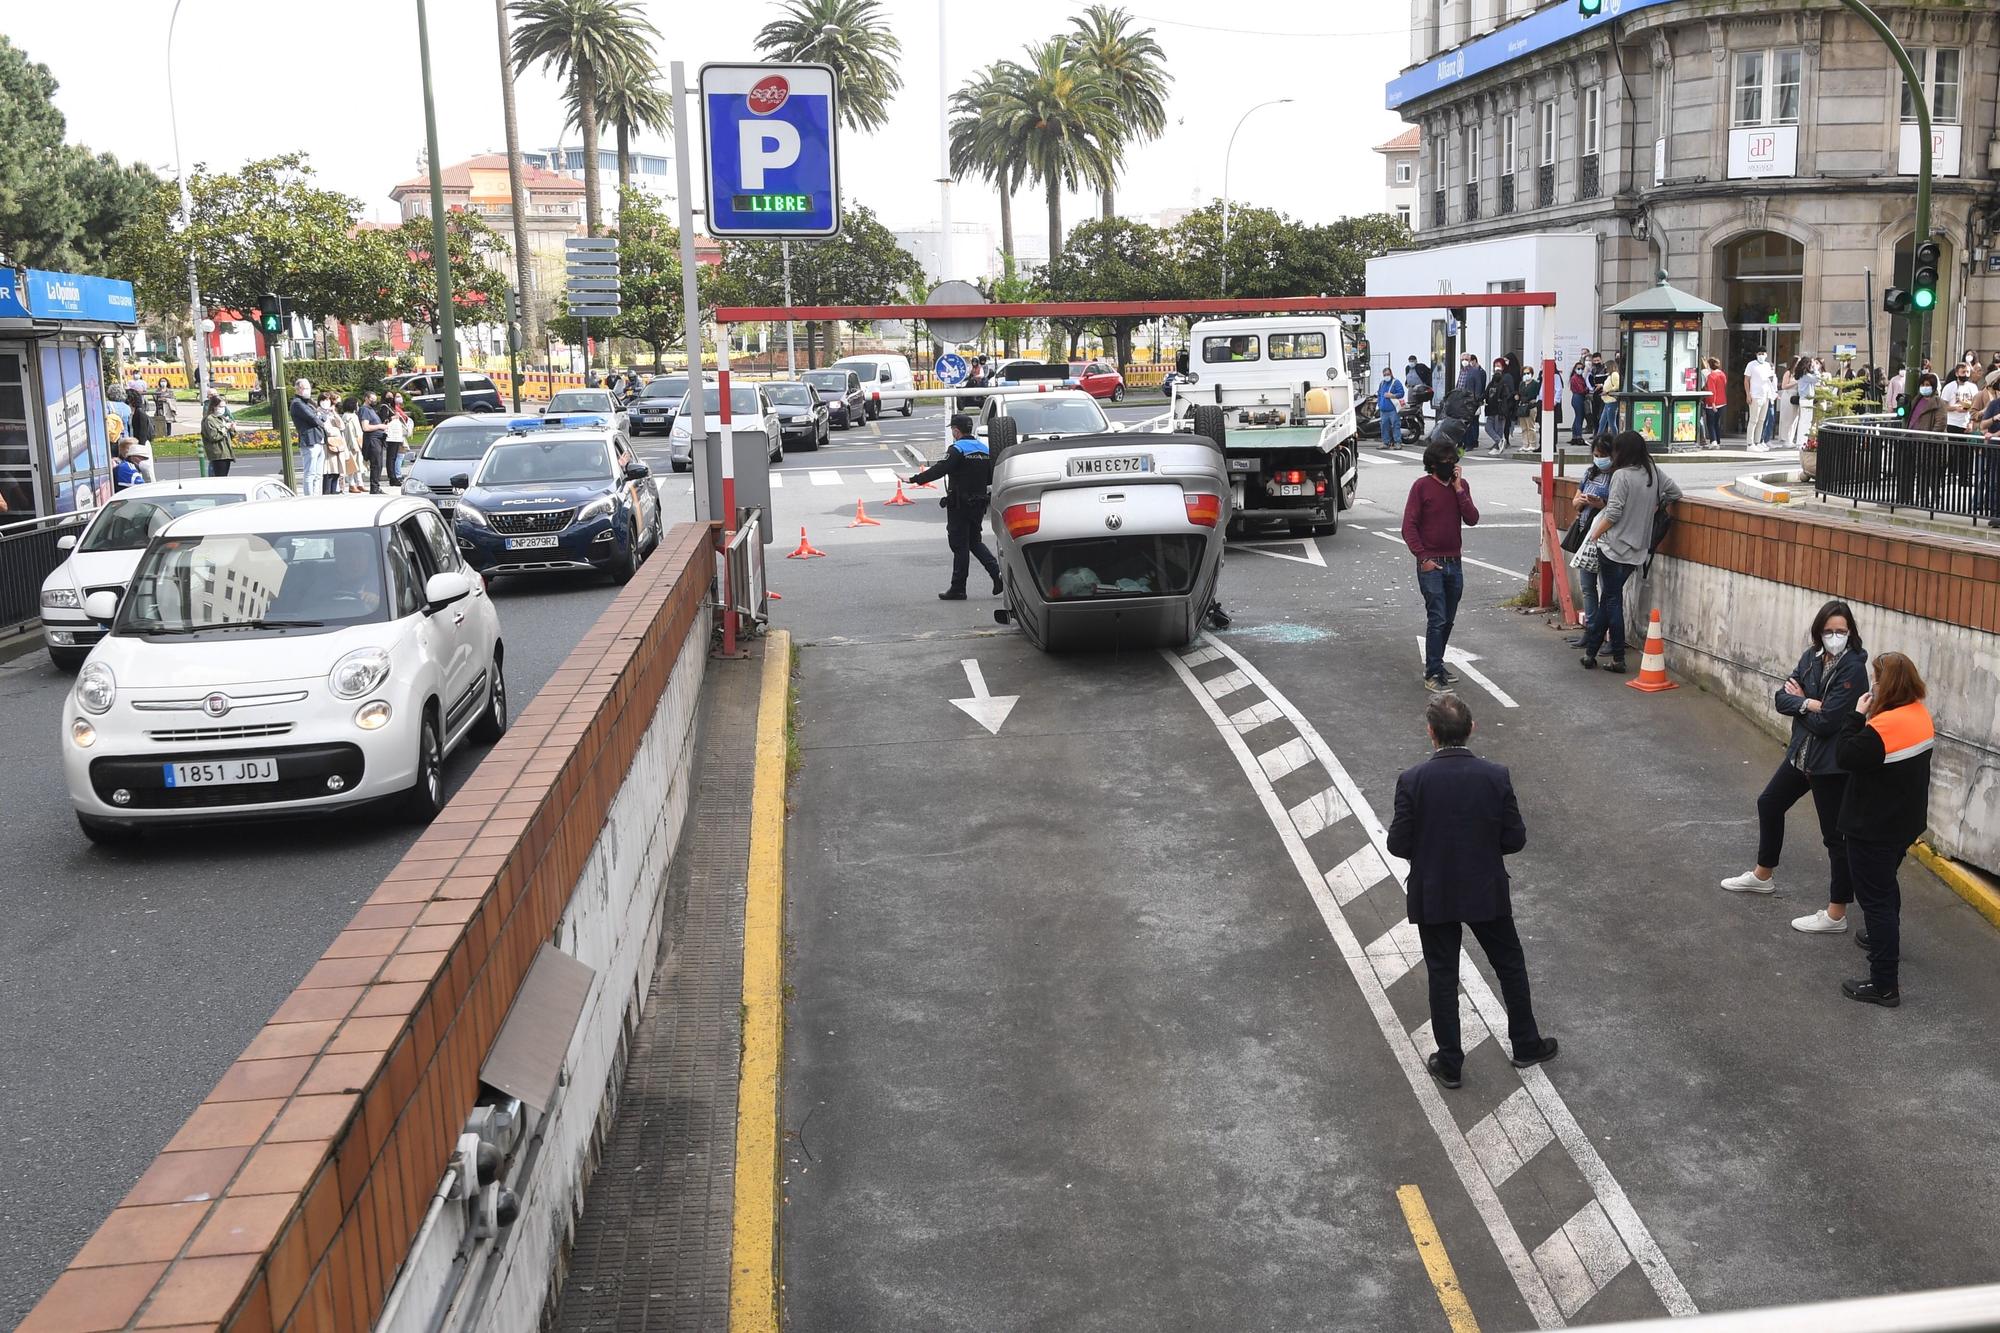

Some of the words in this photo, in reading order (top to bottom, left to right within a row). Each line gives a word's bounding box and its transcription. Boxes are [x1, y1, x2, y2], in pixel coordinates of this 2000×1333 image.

[739, 120, 801, 190] P
[752, 196, 807, 212] LIBRE
[46, 281, 57, 300] La
[1076, 460, 1102, 474] BWK
[1105, 457, 1140, 472] 2433
[179, 764, 225, 783] 1851
[235, 761, 272, 780] JDJ
